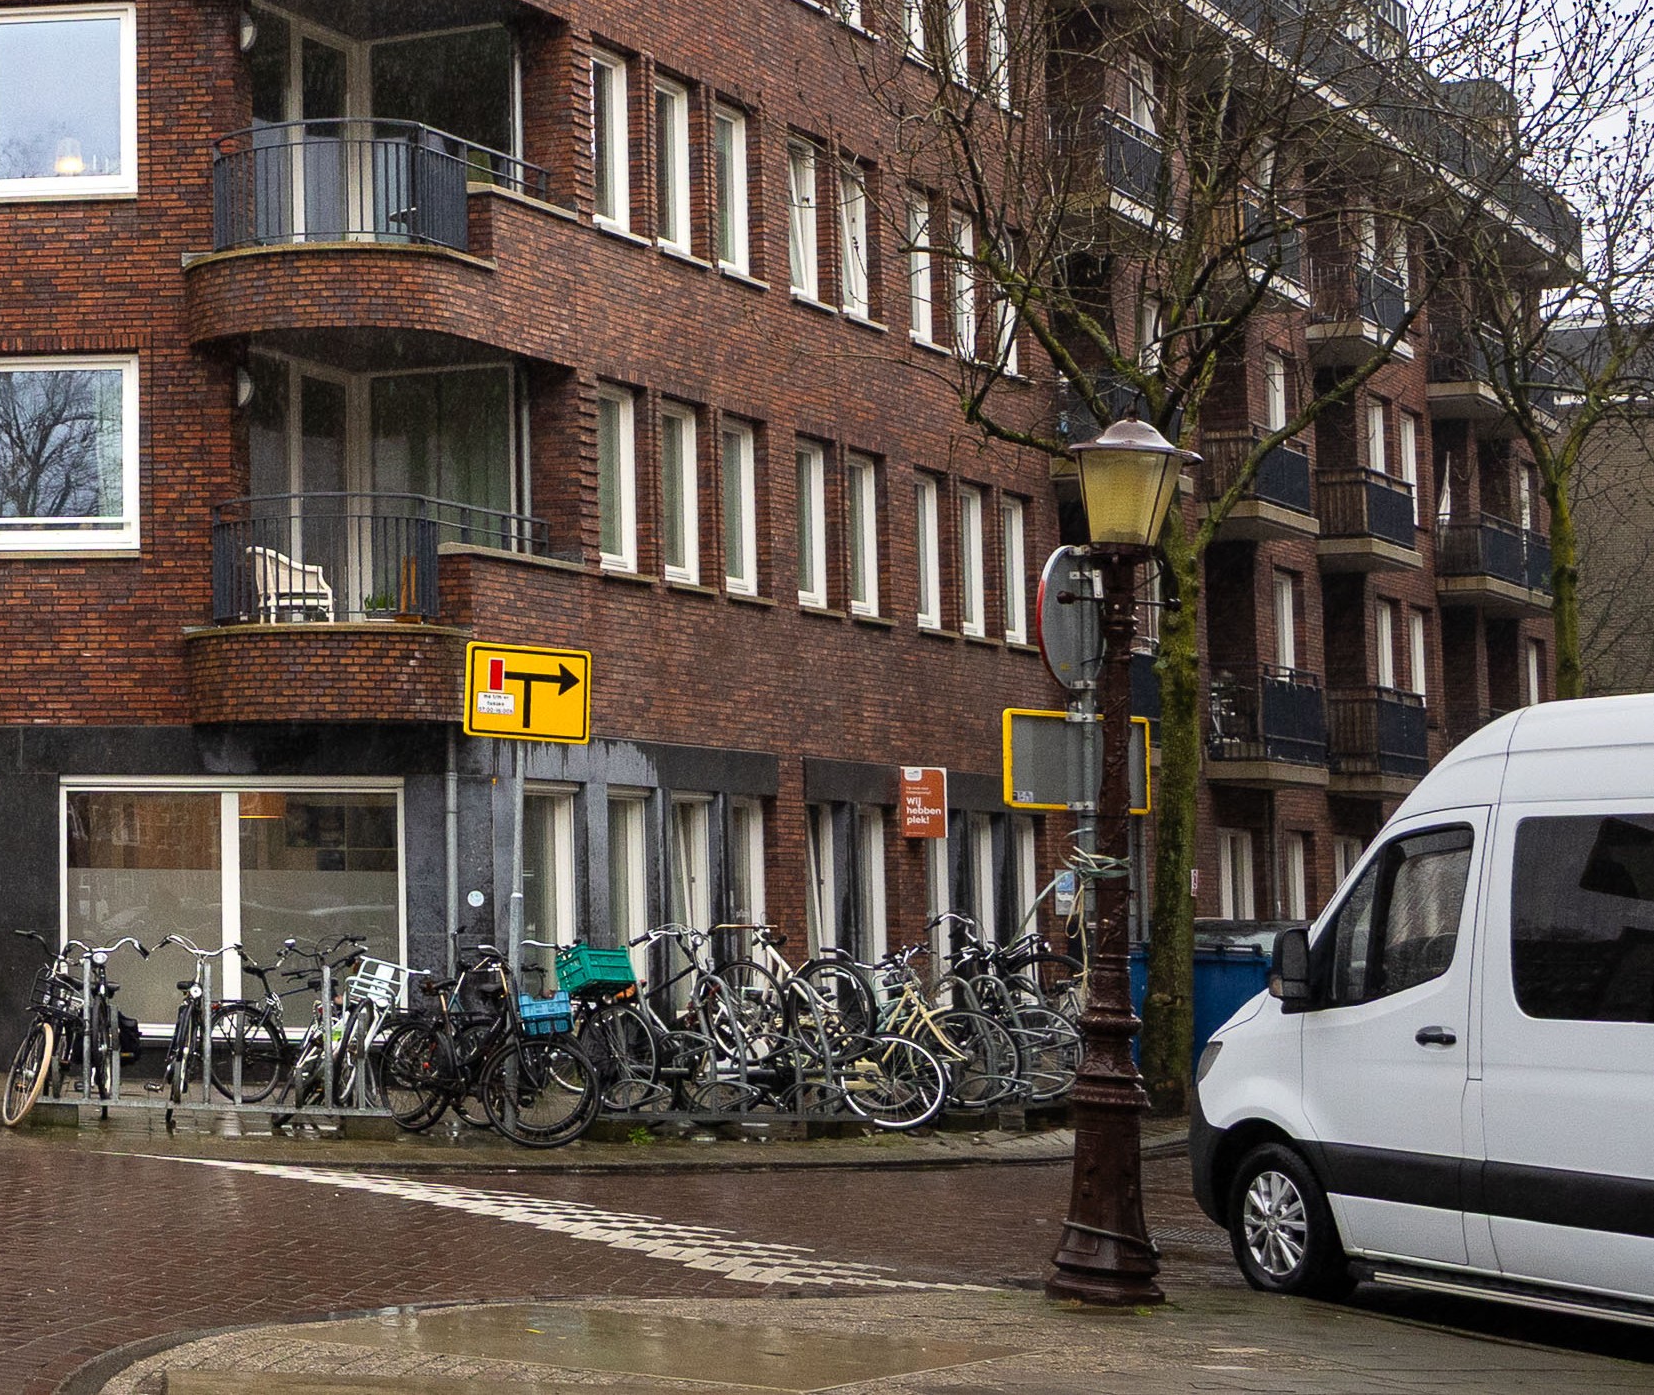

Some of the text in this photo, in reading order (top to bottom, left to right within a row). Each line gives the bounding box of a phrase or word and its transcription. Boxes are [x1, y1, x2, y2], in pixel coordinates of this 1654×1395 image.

[906, 796, 922, 808] Wij
[906, 806, 942, 815] hebben
[906, 816, 930, 826] plek!
